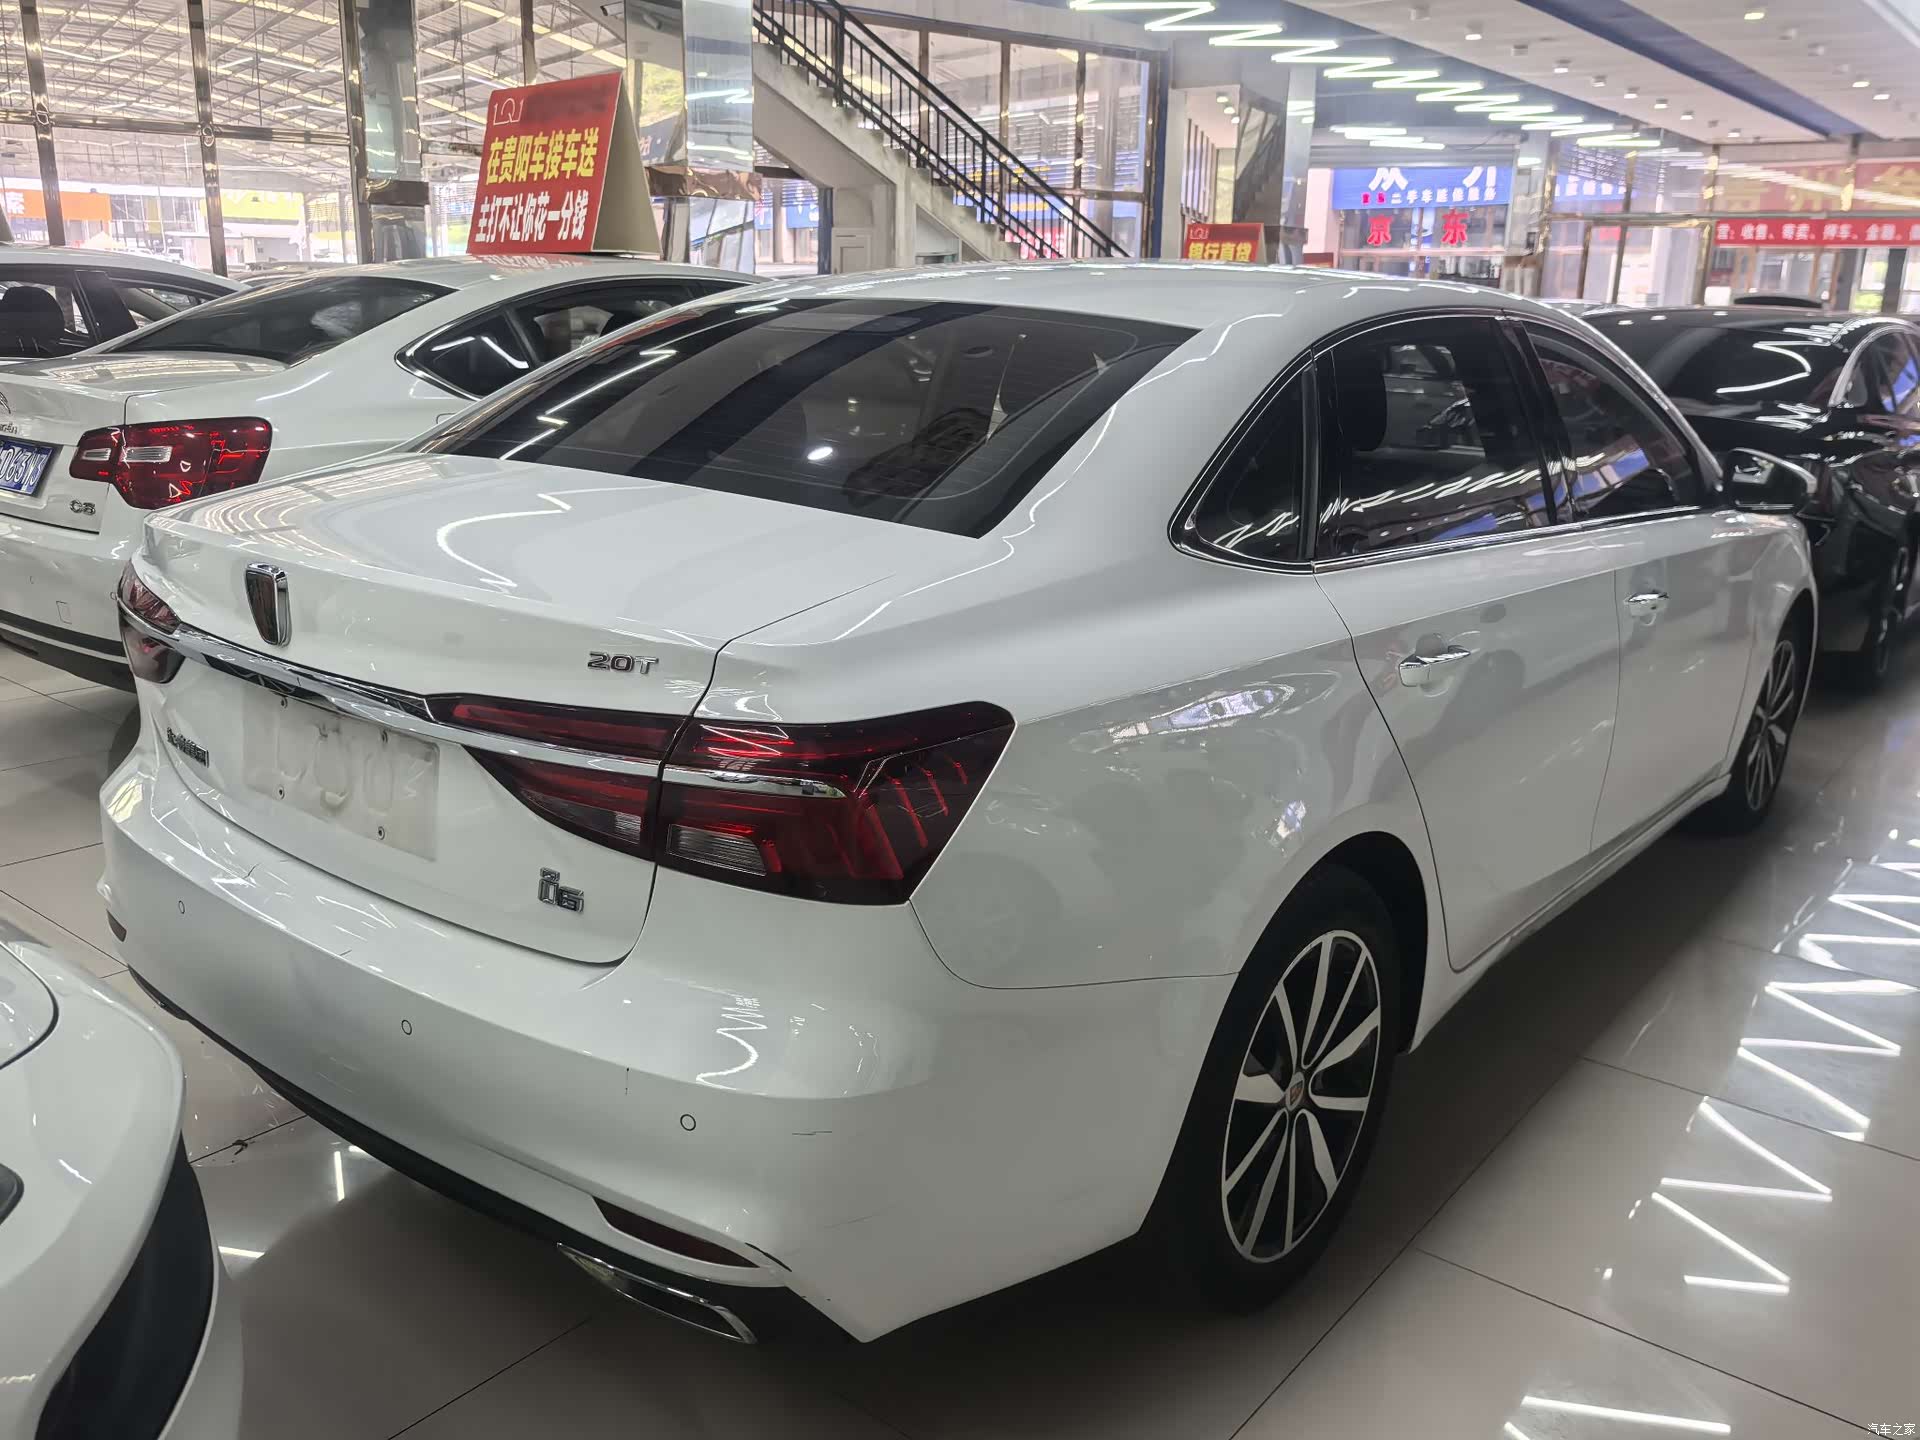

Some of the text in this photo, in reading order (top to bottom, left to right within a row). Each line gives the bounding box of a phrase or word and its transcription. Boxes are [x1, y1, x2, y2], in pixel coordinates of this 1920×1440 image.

[486, 127, 599, 185] 在贵阳车接车送
[475, 189, 589, 243] 主打不让你花一分钱
[587, 651, 660, 674] 20T
